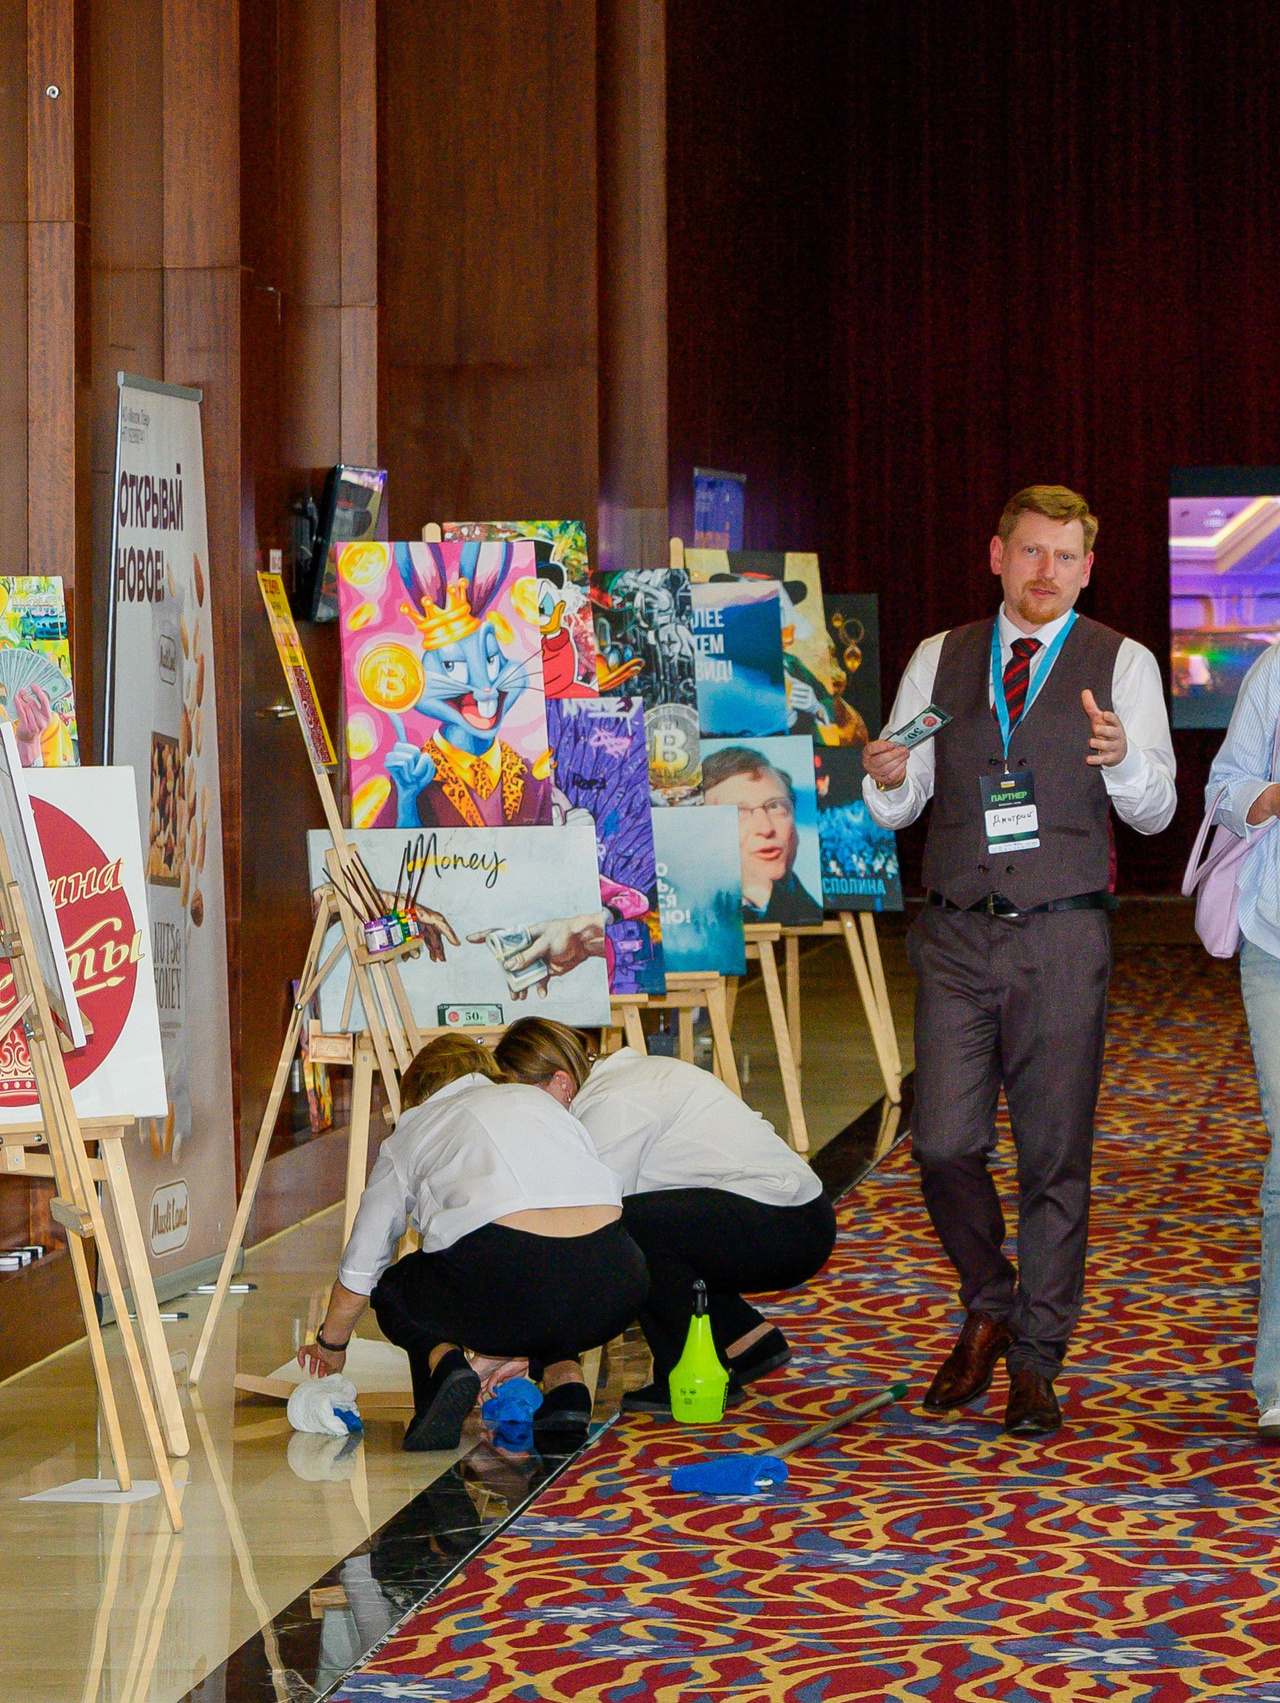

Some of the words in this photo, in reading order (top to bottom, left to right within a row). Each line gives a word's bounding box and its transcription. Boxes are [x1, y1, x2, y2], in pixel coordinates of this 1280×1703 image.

[120, 462, 184, 532] ОТКРЫВАЙ
[117, 545, 165, 603] НОВОЕ!
[991, 791, 1027, 802] ПАРТНЕР
[406, 833, 506, 888] Money
